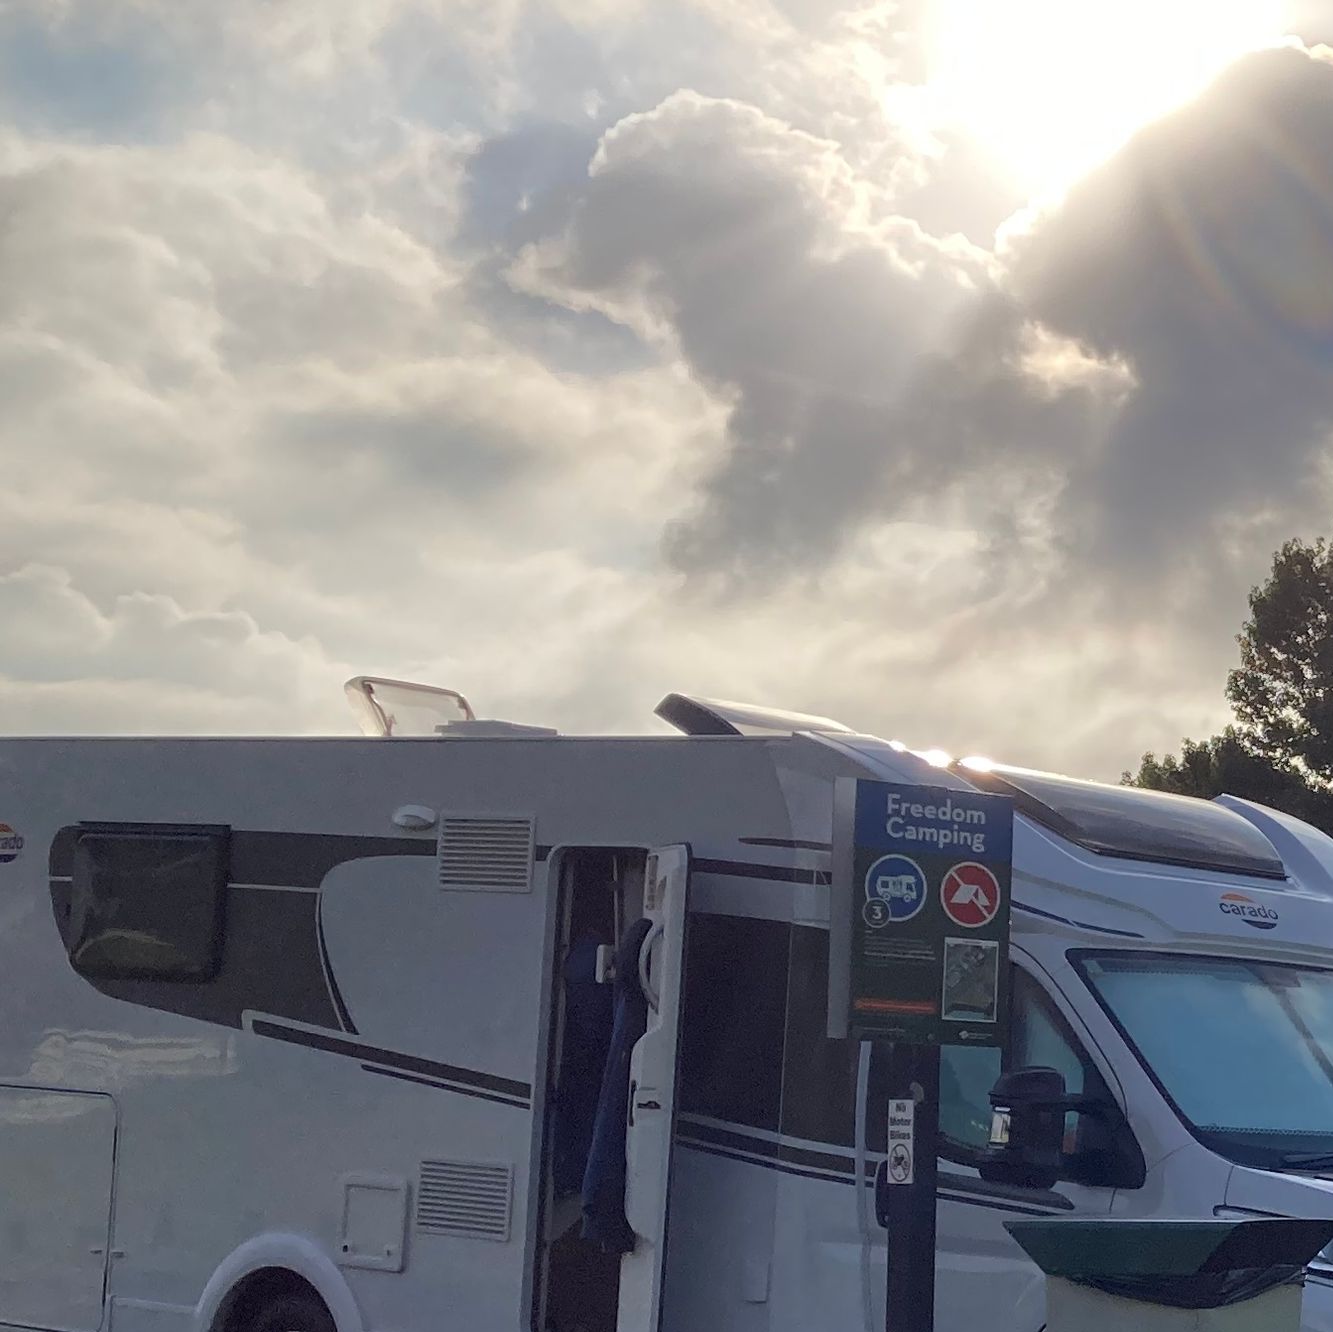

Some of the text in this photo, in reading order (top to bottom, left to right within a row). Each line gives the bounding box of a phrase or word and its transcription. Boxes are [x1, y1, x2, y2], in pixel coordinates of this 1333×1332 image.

[887, 793, 986, 825] Freedom
[886, 816, 985, 853] Camping
[872, 905, 882, 920] 3
[1219, 902, 1279, 920] carado
